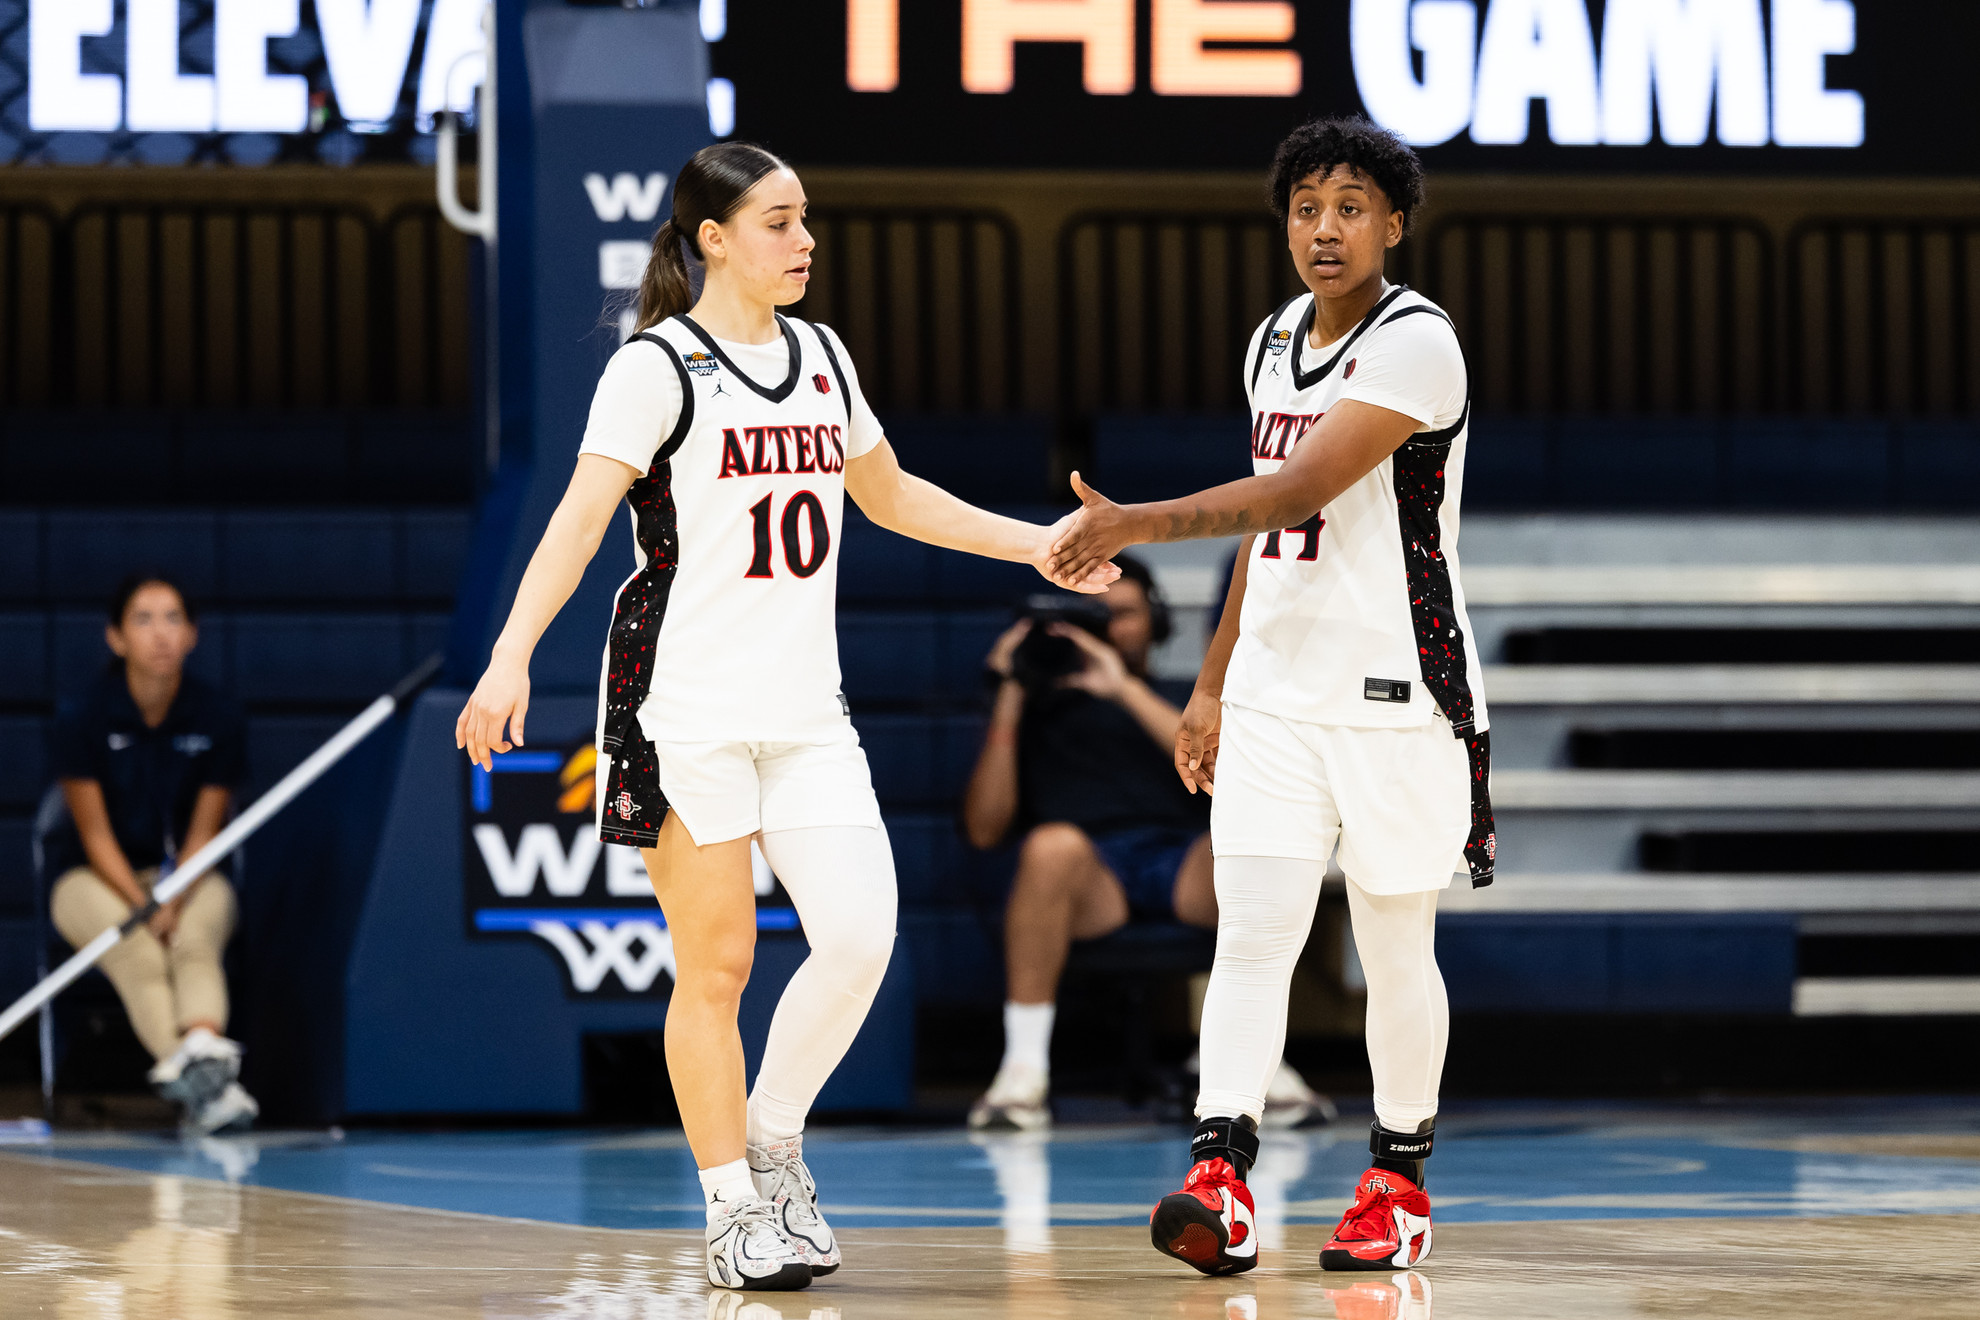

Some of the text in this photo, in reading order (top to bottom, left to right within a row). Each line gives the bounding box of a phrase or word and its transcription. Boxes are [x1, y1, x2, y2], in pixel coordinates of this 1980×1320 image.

[1350, 0, 1865, 148] GAME
[685, 359, 716, 368] WBIT
[717, 424, 845, 479] AZTECS
[1251, 411, 1326, 461] AZTE
[743, 490, 831, 579] 10
[1397, 687, 1403, 697] L
